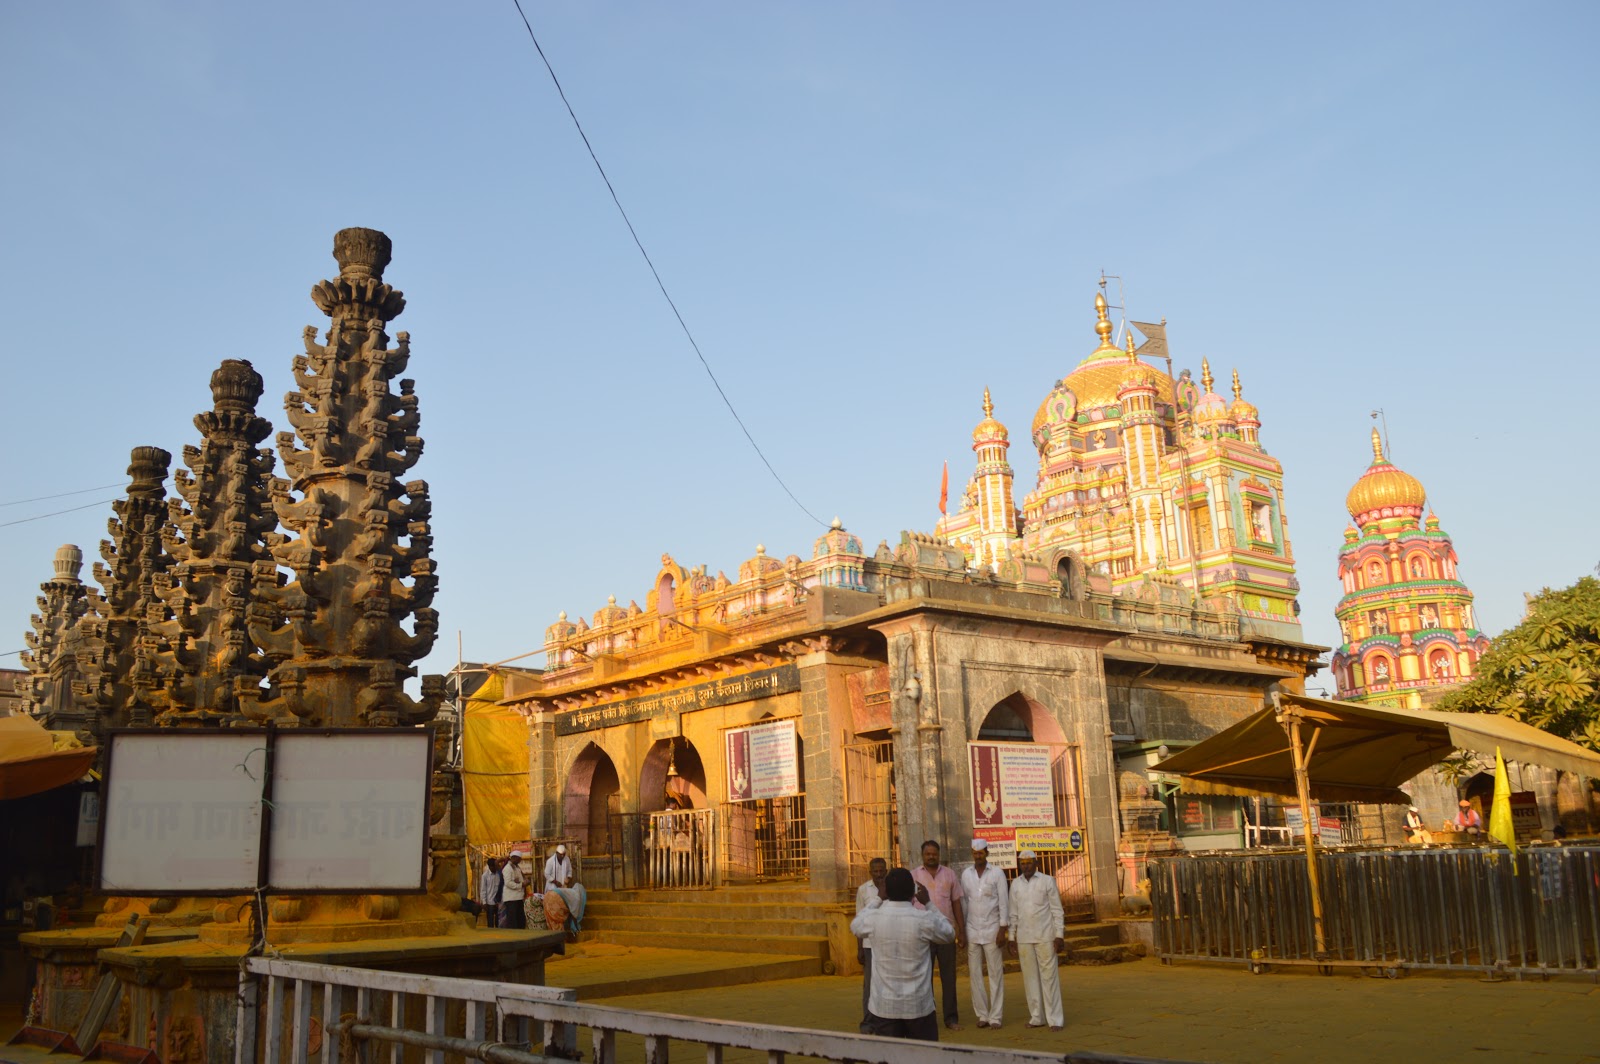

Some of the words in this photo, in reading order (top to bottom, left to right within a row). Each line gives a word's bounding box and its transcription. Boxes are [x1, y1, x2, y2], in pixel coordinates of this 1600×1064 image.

[602, 705, 617, 719] पर्वत
[698, 686, 714, 706] दुसरे
[716, 680, 742, 697] कैलास
[744, 676, 769, 692] शिखर
